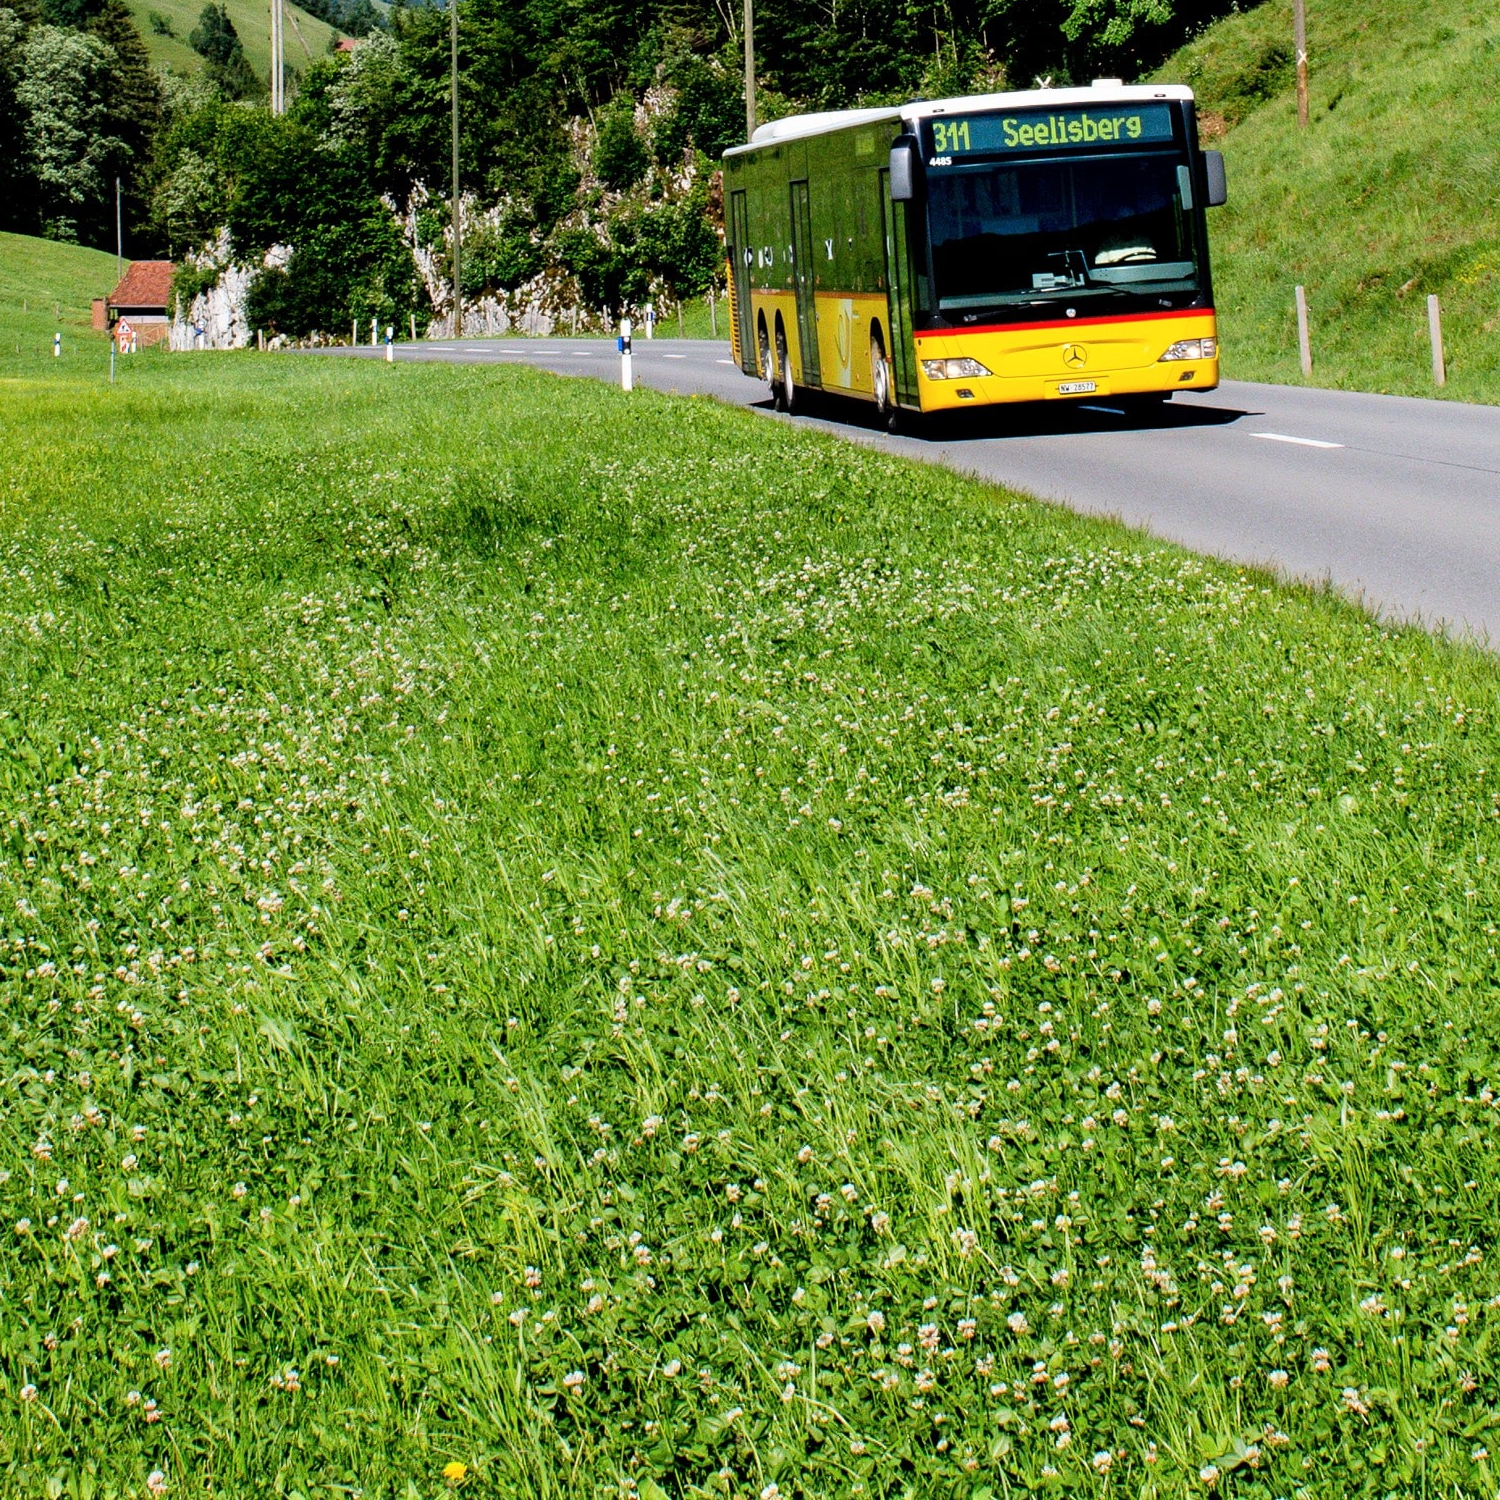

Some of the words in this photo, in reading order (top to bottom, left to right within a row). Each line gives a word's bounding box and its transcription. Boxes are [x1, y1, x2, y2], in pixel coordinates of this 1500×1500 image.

[932, 121, 971, 152] 311
[1002, 114, 1142, 147] Seelisberg
[929, 156, 953, 166] 4485
